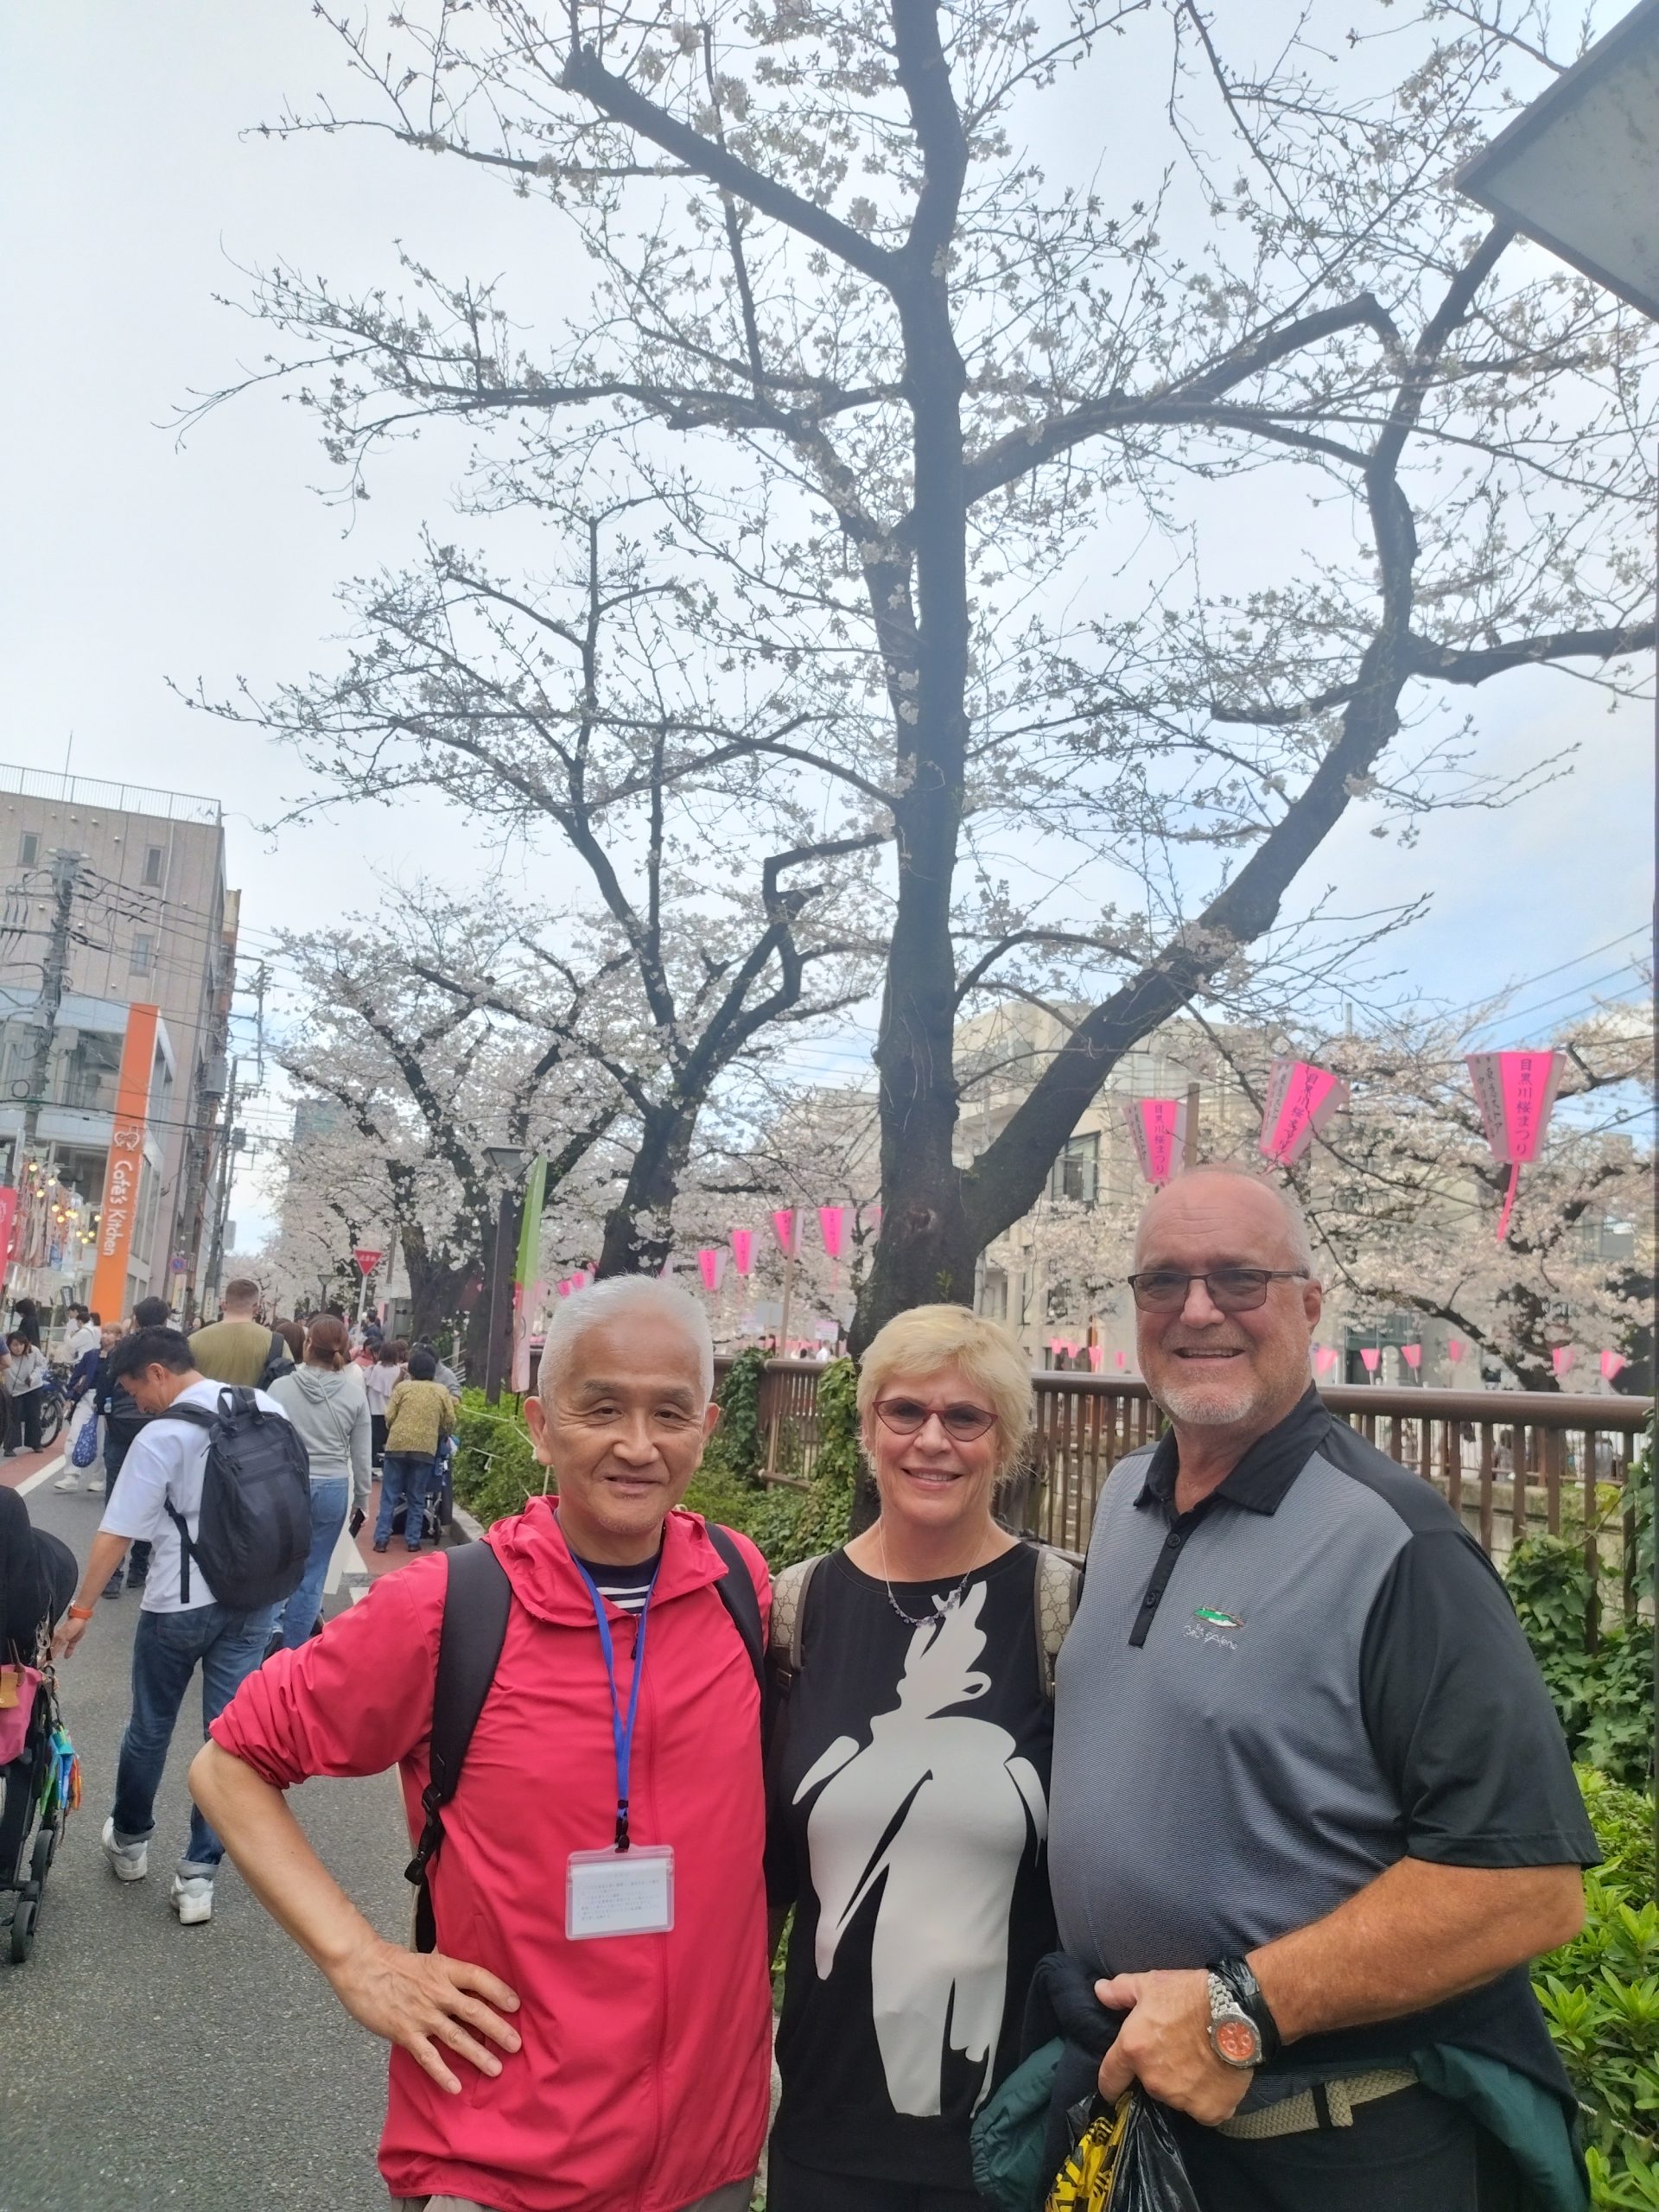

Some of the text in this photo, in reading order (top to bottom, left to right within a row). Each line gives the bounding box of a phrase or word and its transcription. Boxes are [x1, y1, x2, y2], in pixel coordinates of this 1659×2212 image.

[1154, 1104, 1166, 1174] 目黒川桜まつり
[1515, 1058, 1533, 1155] 目黒川桜まつり
[103, 1209, 127, 1256] Kitchen
